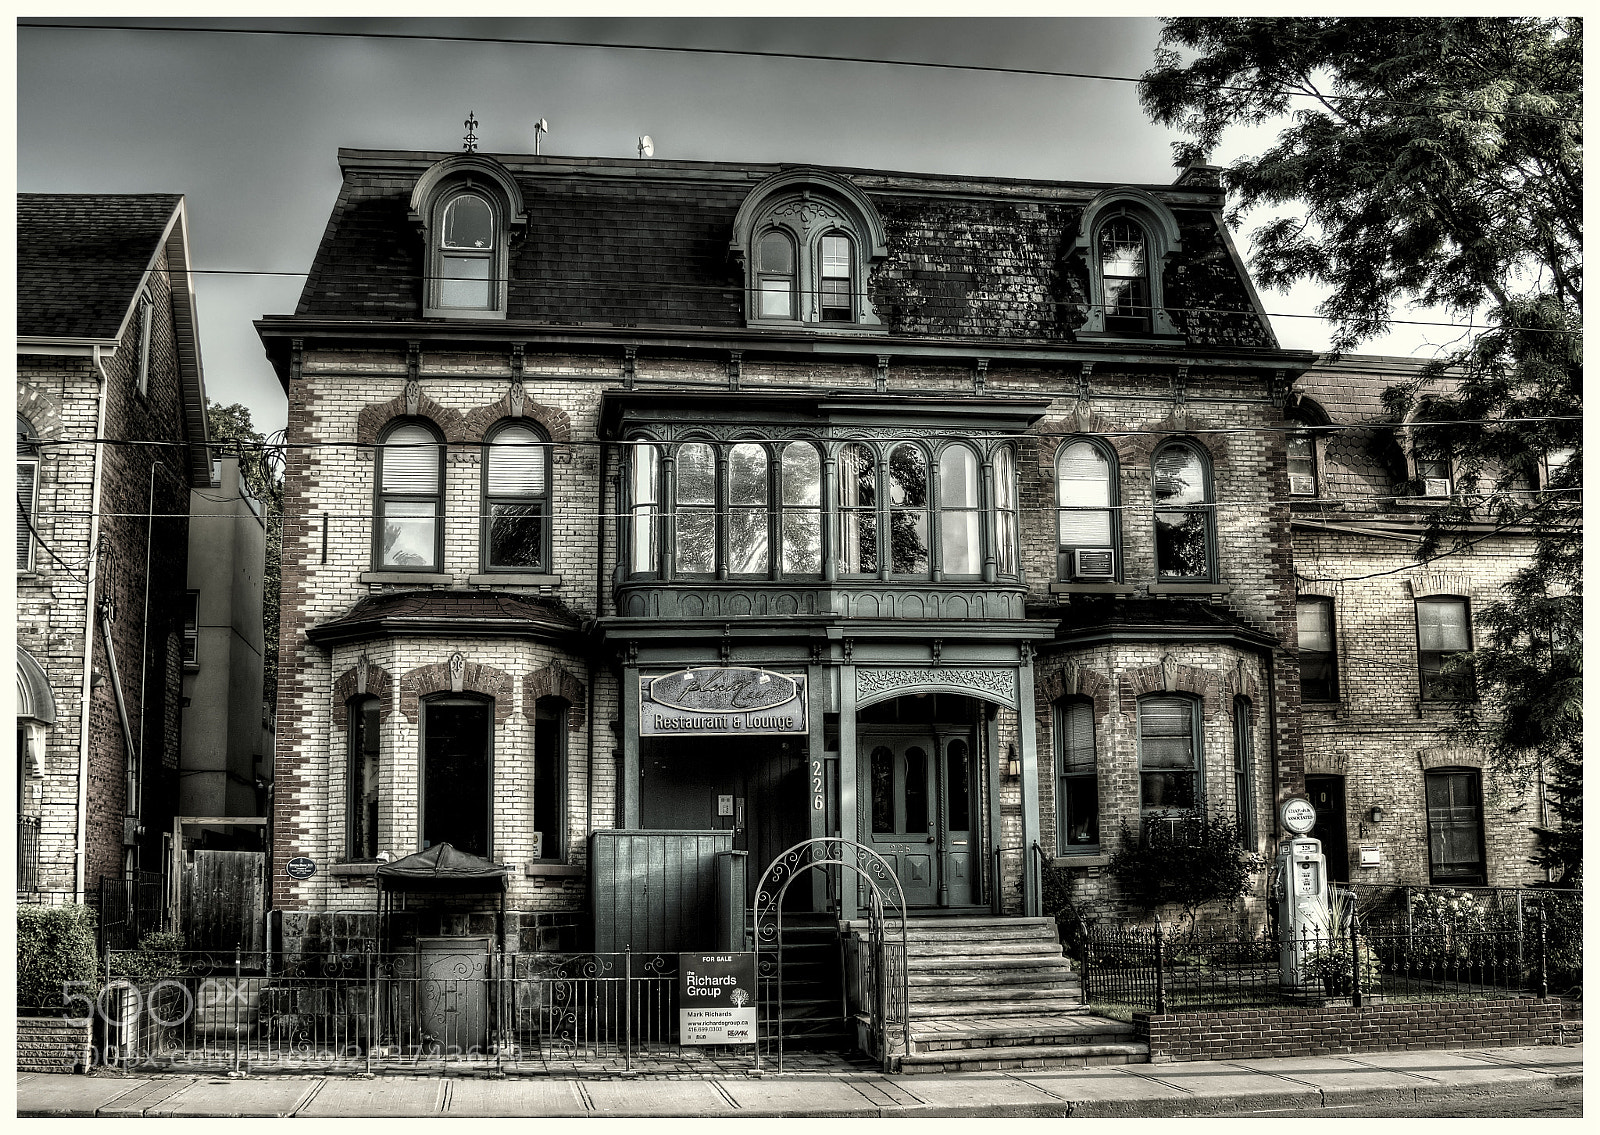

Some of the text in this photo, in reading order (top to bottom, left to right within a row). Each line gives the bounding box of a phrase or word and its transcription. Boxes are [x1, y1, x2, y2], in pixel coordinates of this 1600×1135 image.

[654, 712, 793, 731] Restaurant & Lounge
[812, 761, 824, 810] 226
[687, 975, 736, 986] Richards
[687, 986, 721, 998] Group
[687, 1020, 749, 1028] www.richardsgroup.ca
